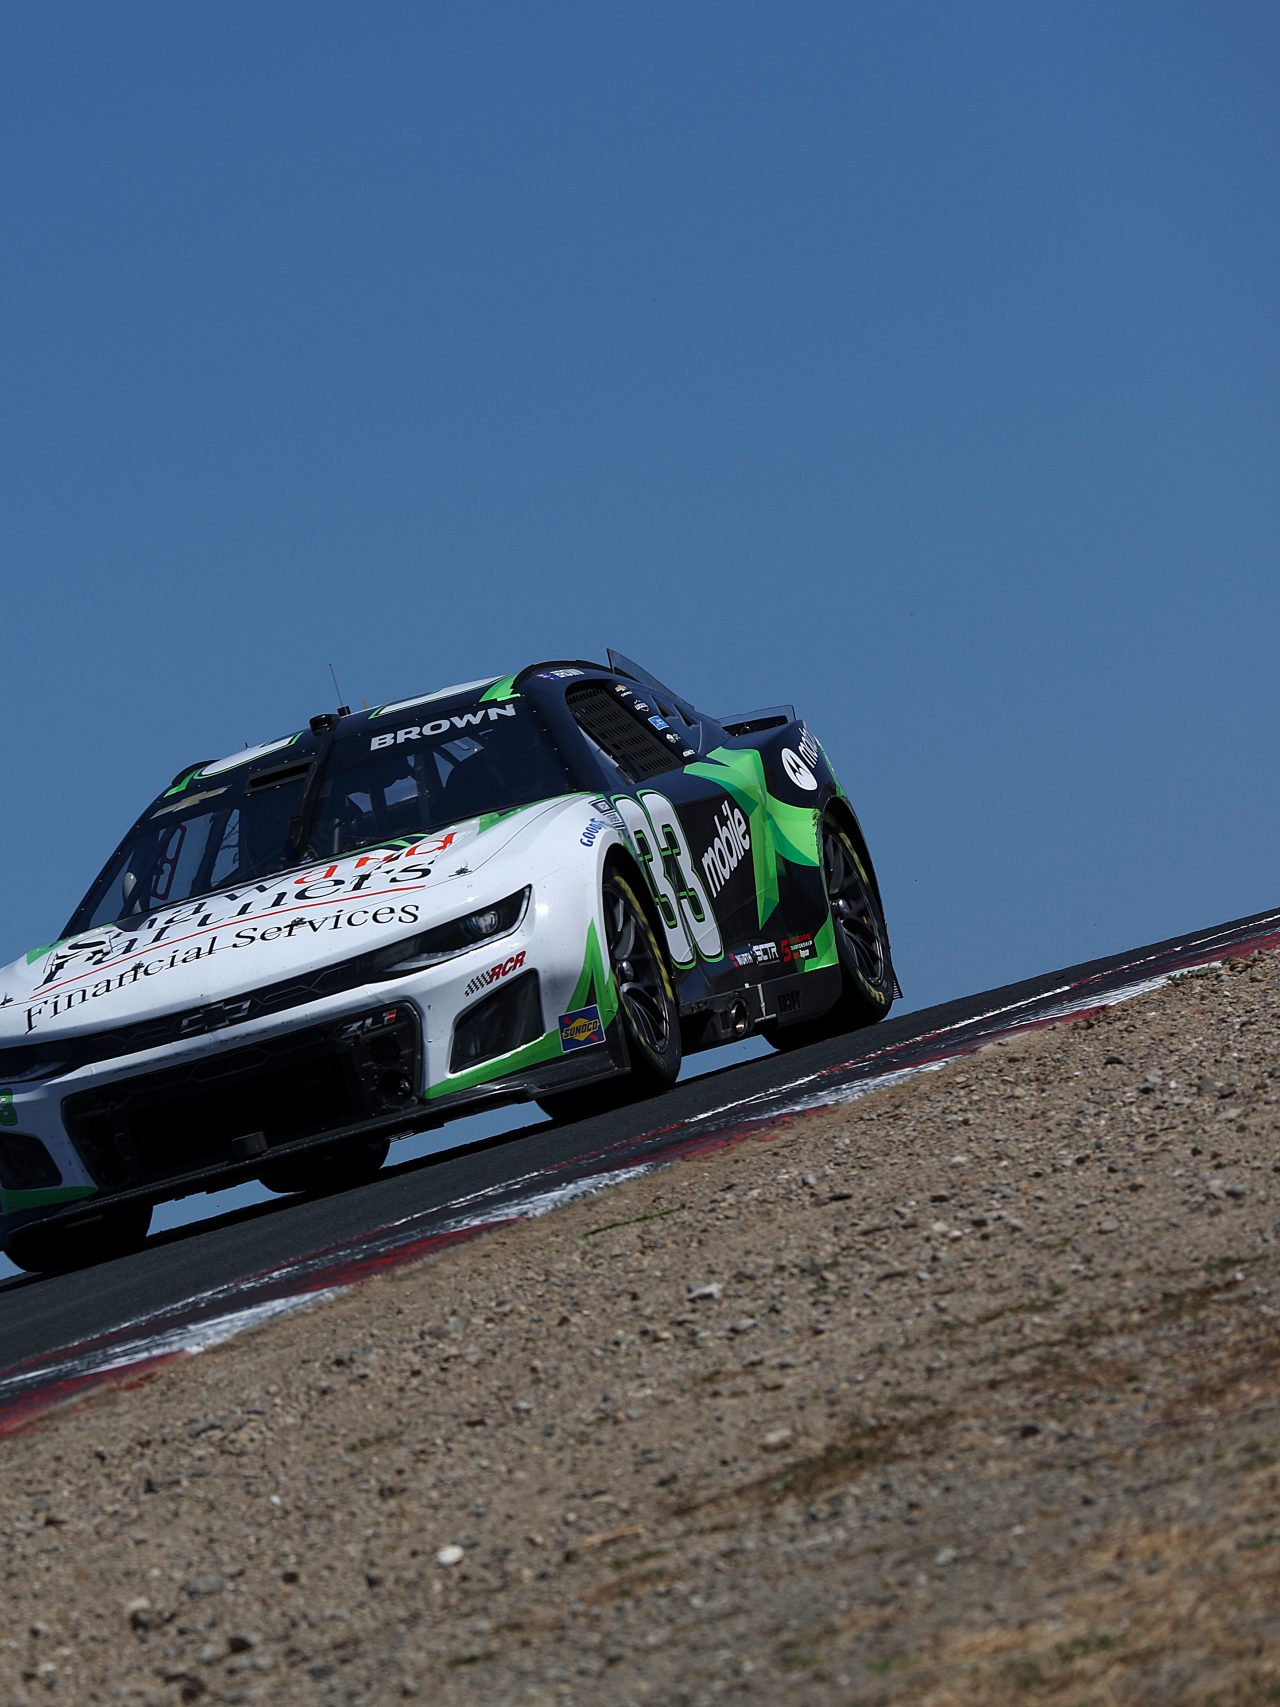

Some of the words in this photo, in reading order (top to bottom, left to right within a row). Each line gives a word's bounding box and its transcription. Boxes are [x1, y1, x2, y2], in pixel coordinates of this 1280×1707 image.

[370, 703, 516, 751] BROWN
[701, 800, 750, 898] mobile
[610, 789, 724, 970] 33
[22, 935, 217, 1035] Financial
[231, 903, 419, 949] Services
[489, 950, 527, 984] RCR
[340, 1008, 397, 1039] ZL1
[562, 1020, 601, 1040] SUNOCO
